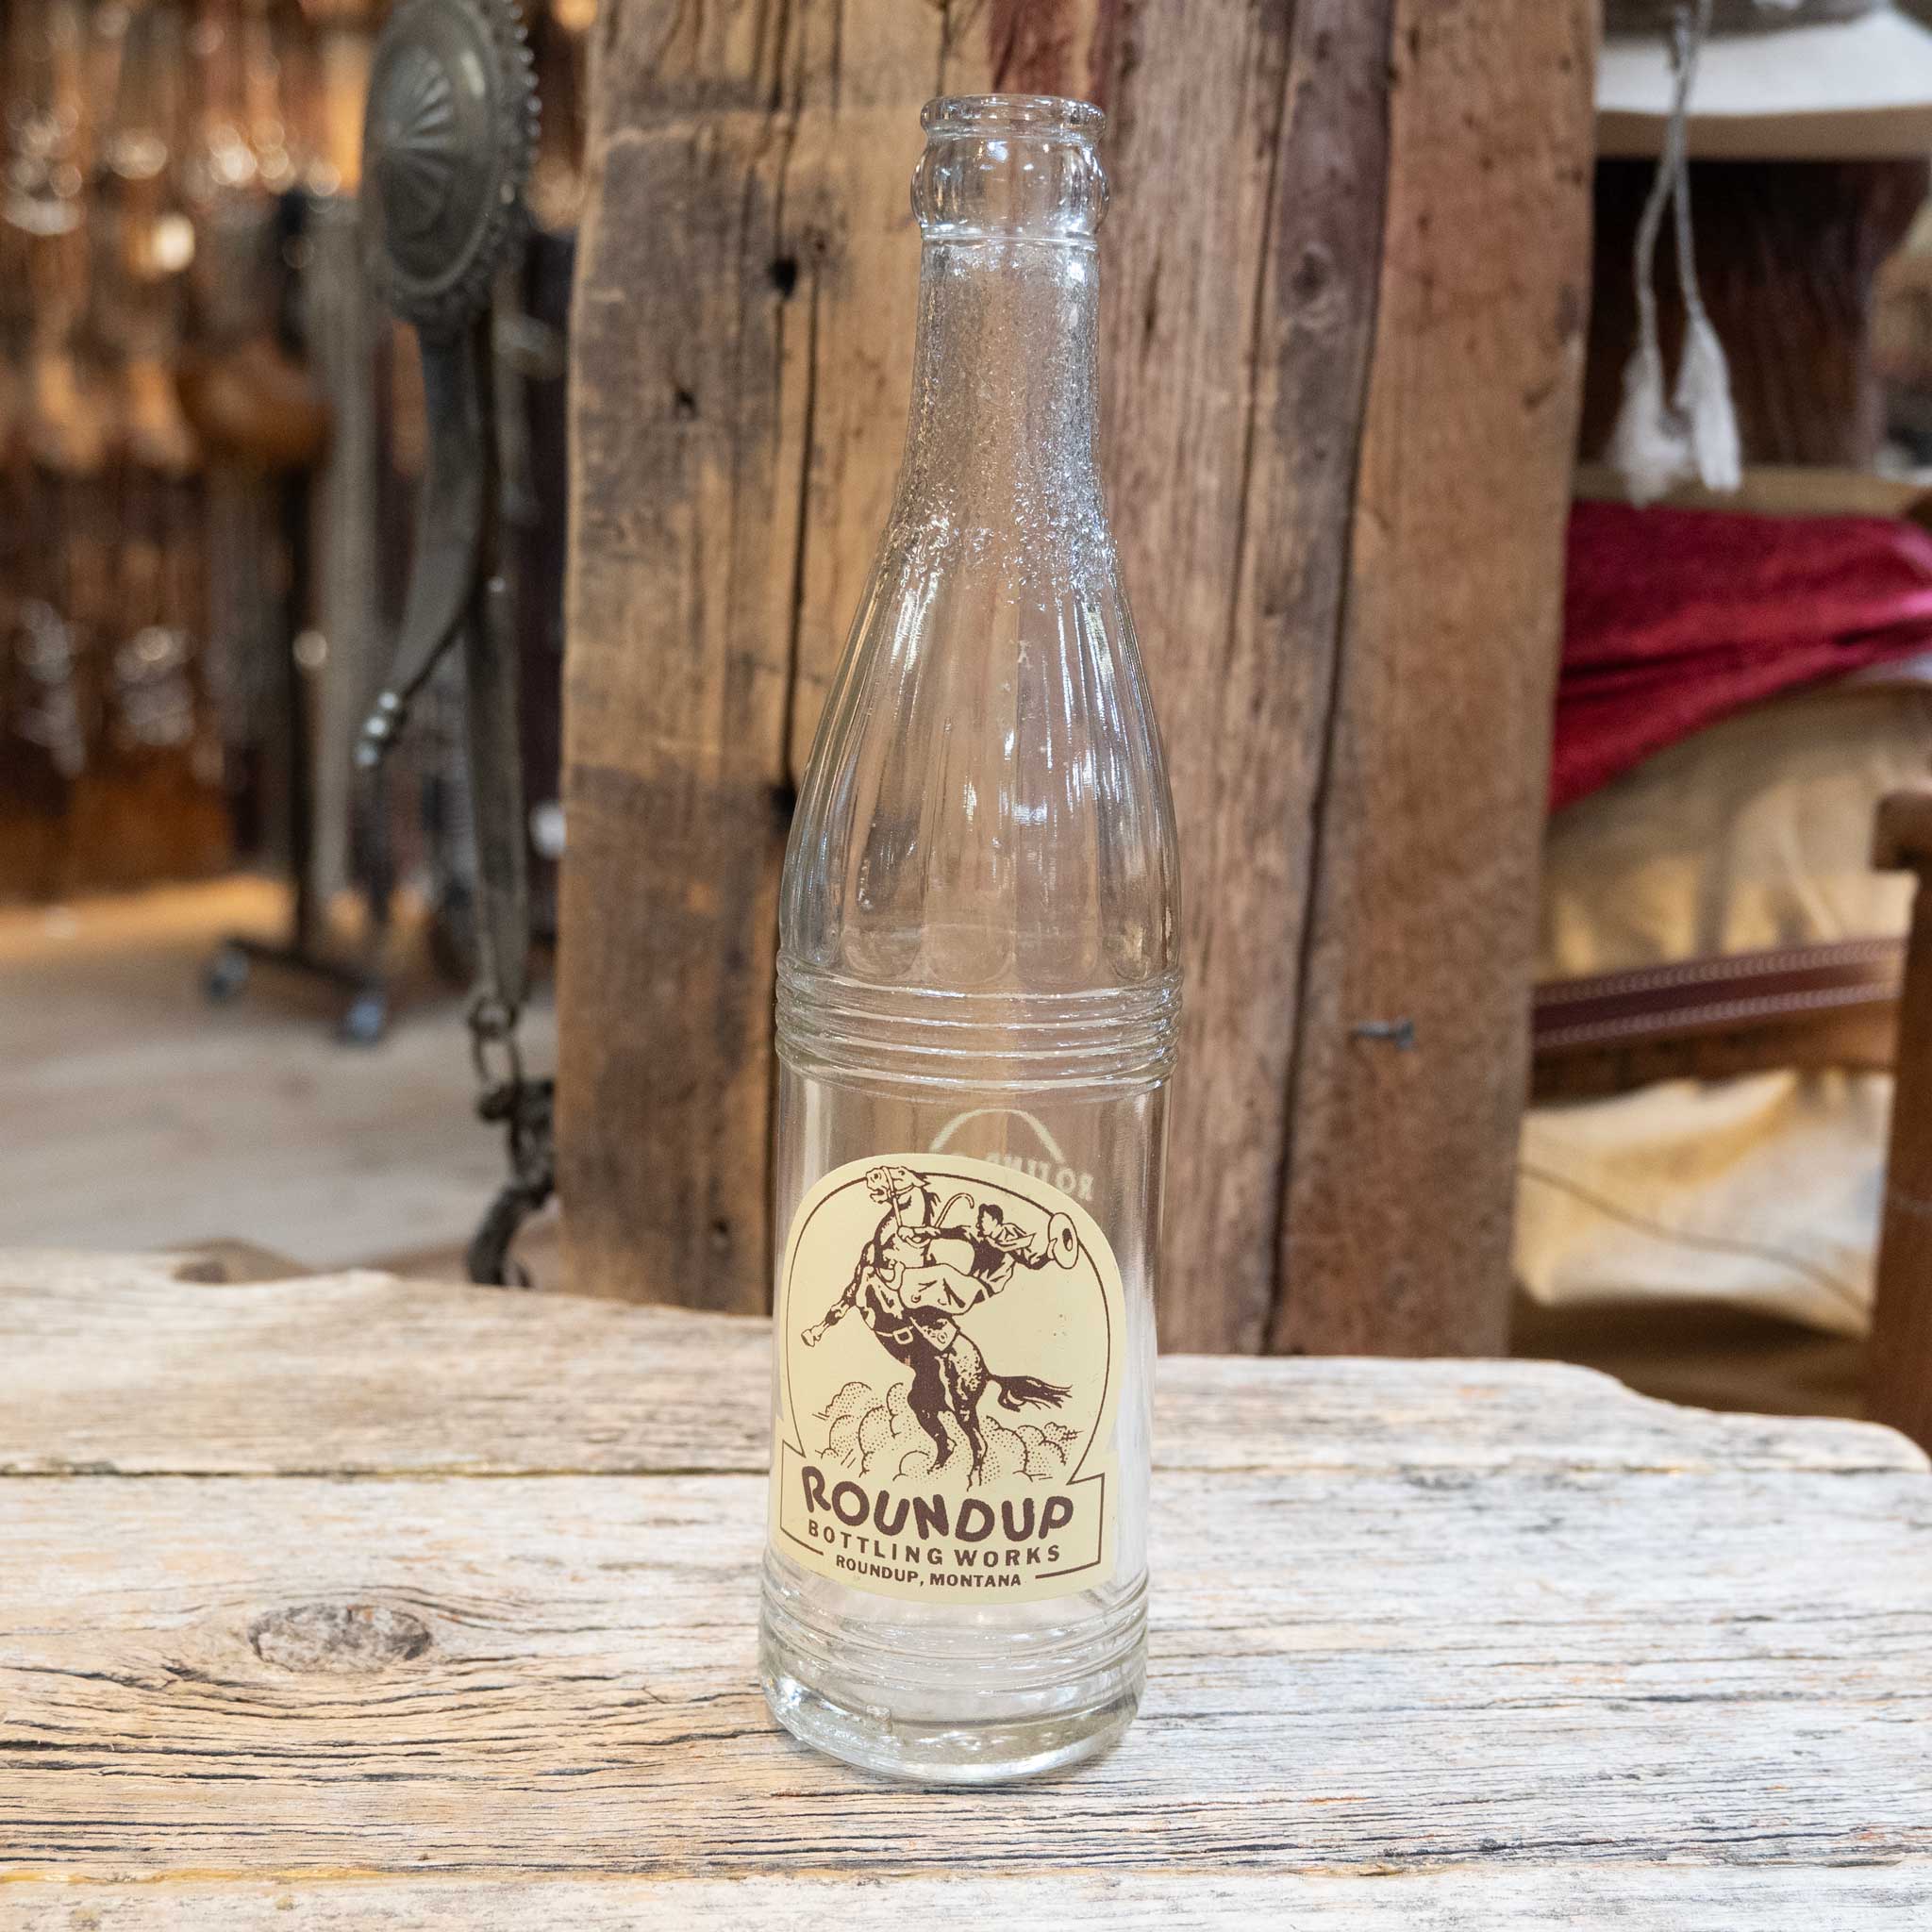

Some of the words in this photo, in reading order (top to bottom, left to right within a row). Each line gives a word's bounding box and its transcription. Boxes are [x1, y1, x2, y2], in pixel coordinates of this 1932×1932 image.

[801, 1465, 1074, 1543] ROUNDUP
[808, 1519, 943, 1565] BOTTLING
[953, 1544, 1060, 1568] WORKS
[836, 1554, 924, 1588] ROUNDUP,
[929, 1573, 1022, 1589] MONTANA
